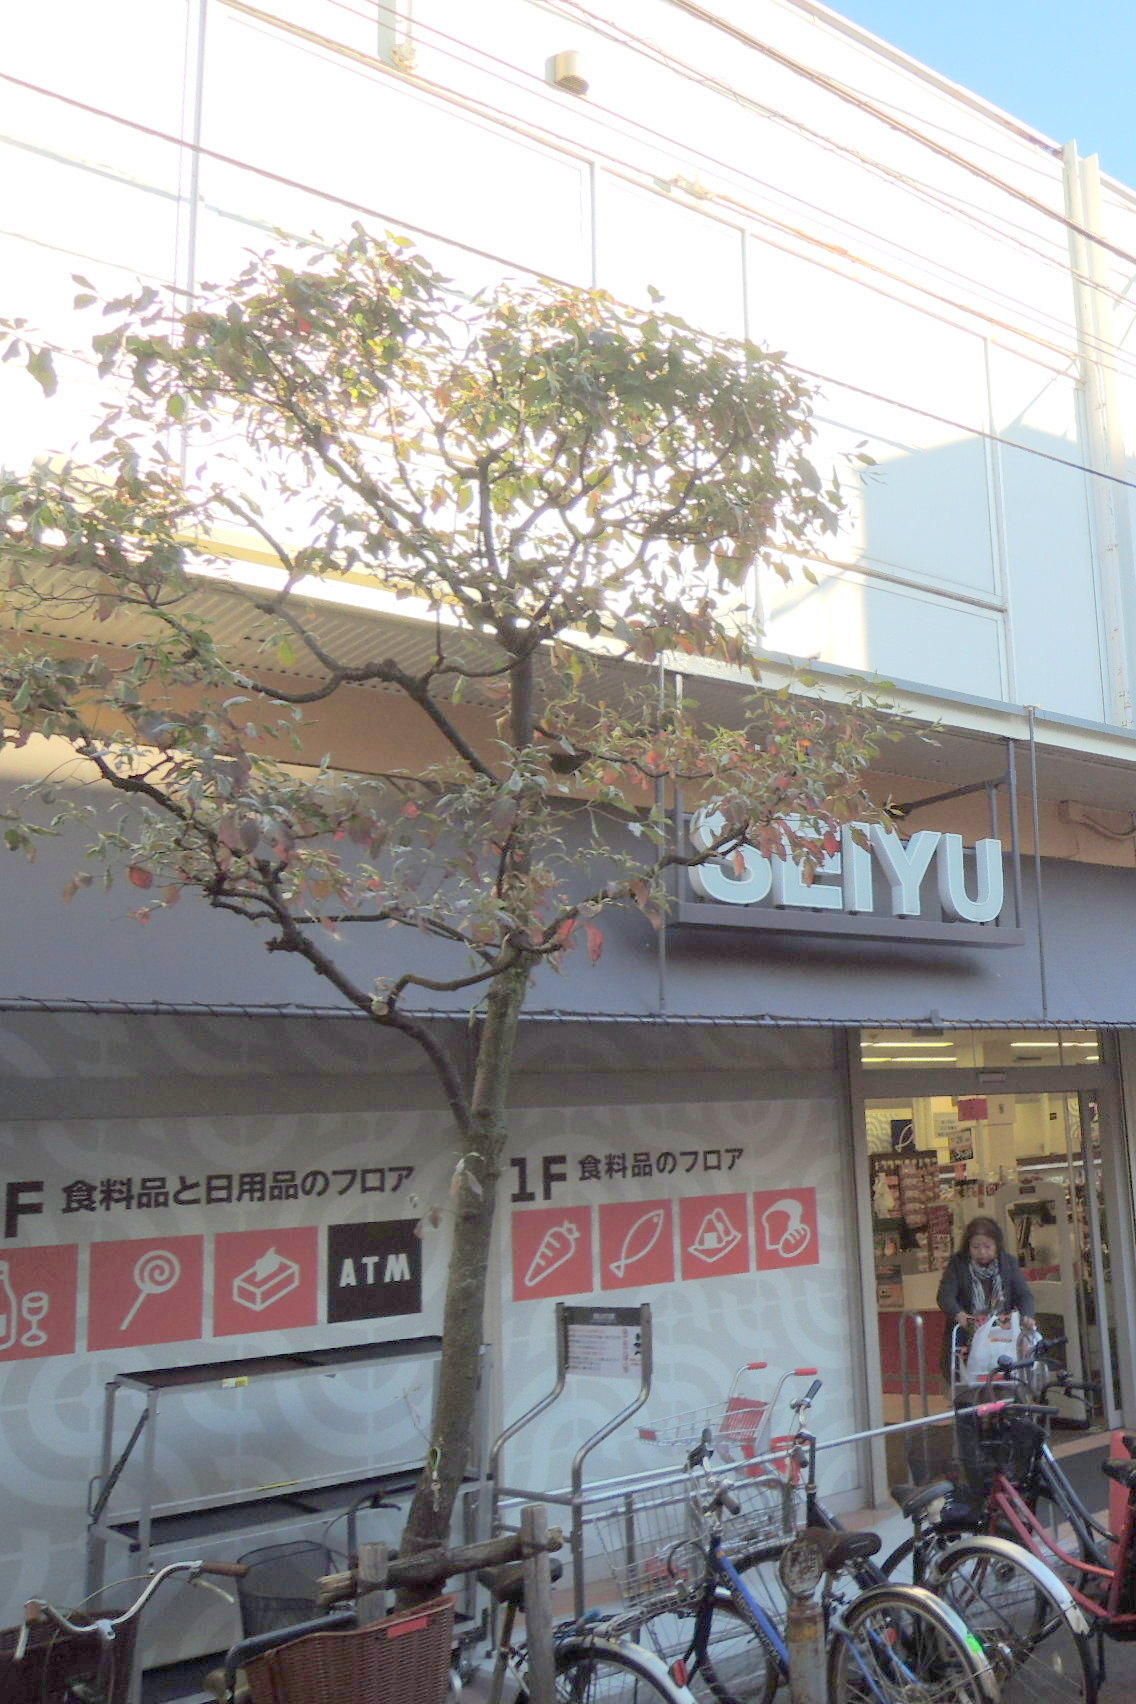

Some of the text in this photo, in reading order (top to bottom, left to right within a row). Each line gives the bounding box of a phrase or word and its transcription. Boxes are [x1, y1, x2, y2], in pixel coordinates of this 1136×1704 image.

[688, 803, 1004, 923] SEIYU
[62, 1165, 415, 1214] 食料品と日用品のフロア
[510, 1148, 744, 1203] 1F 食料品のフロア
[339, 1253, 411, 1288] ATM
